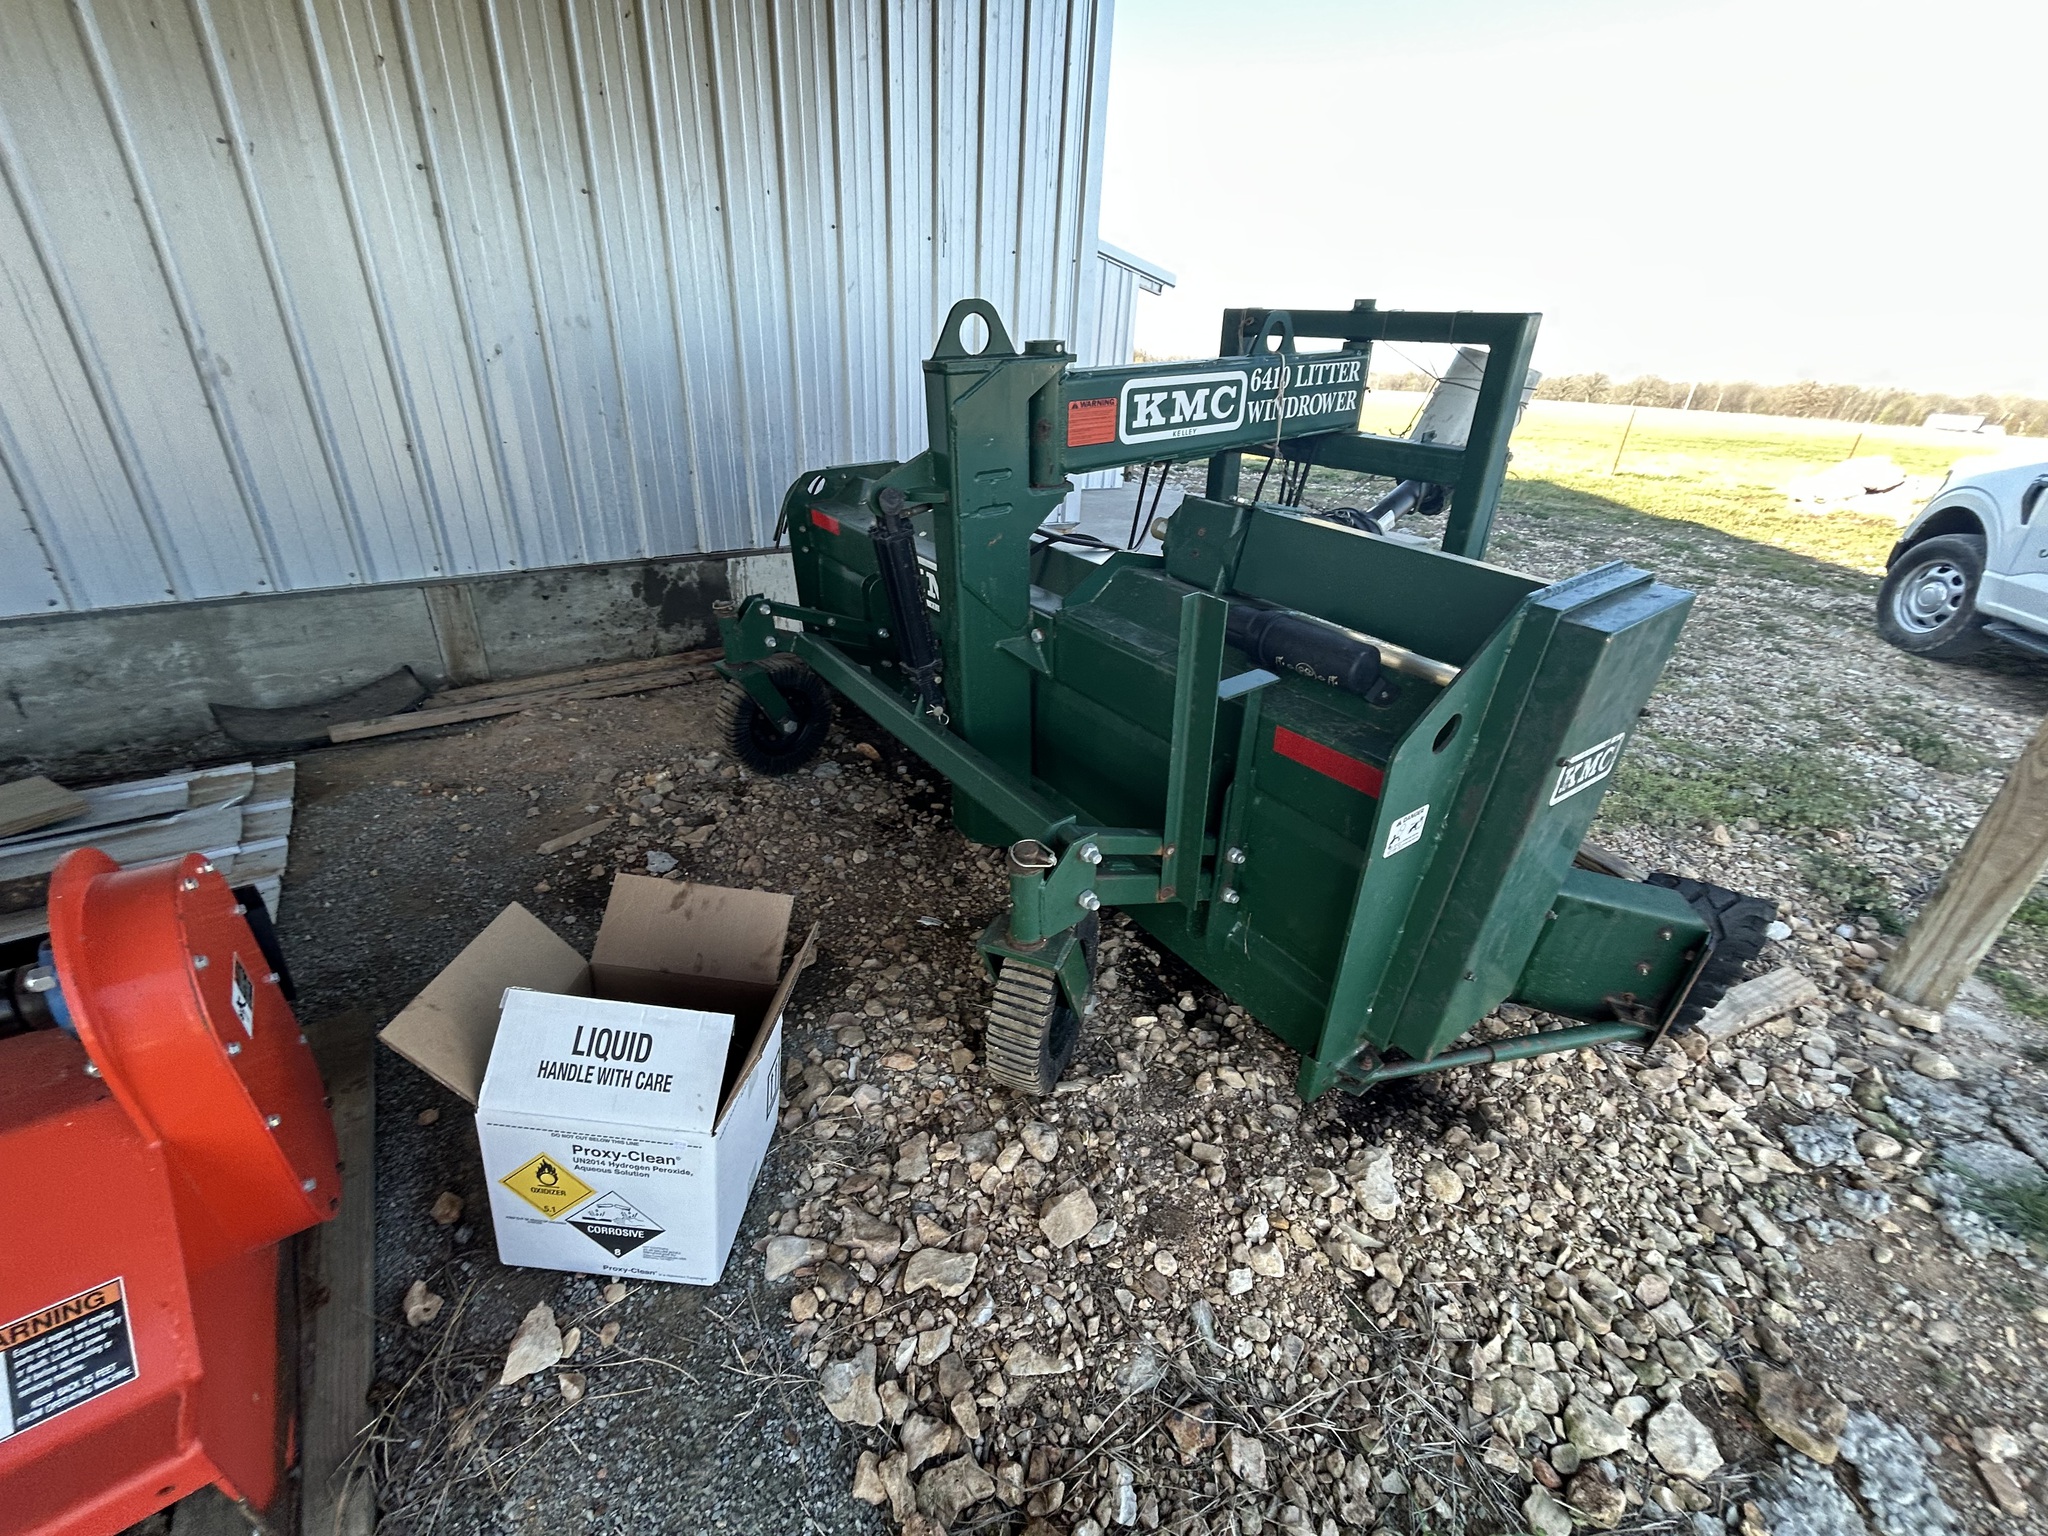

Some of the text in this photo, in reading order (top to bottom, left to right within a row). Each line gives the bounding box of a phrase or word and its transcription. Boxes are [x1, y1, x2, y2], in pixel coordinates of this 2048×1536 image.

[1250, 361, 1360, 392] 6410 LITTER
[1080, 398, 1115, 408] WARNING
[1132, 385, 1238, 428] KMC
[1247, 390, 1357, 423] WINDROWER
[1172, 428, 1198, 437] KELLEY
[1558, 746, 1616, 794] KMC
[571, 1025, 653, 1063] LIQUID
[537, 1060, 673, 1092] HANDLE WITH CARE
[572, 1157, 694, 1176] UN2014 Hydrogen Peroxide,
[574, 1164, 650, 1178] Aqueous Solution
[530, 1186, 567, 1197] OXIDIZER
[543, 1205, 556, 1213] 5.1
[587, 1225, 645, 1239] CORROSIVE
[614, 1248, 621, 1256] 8
